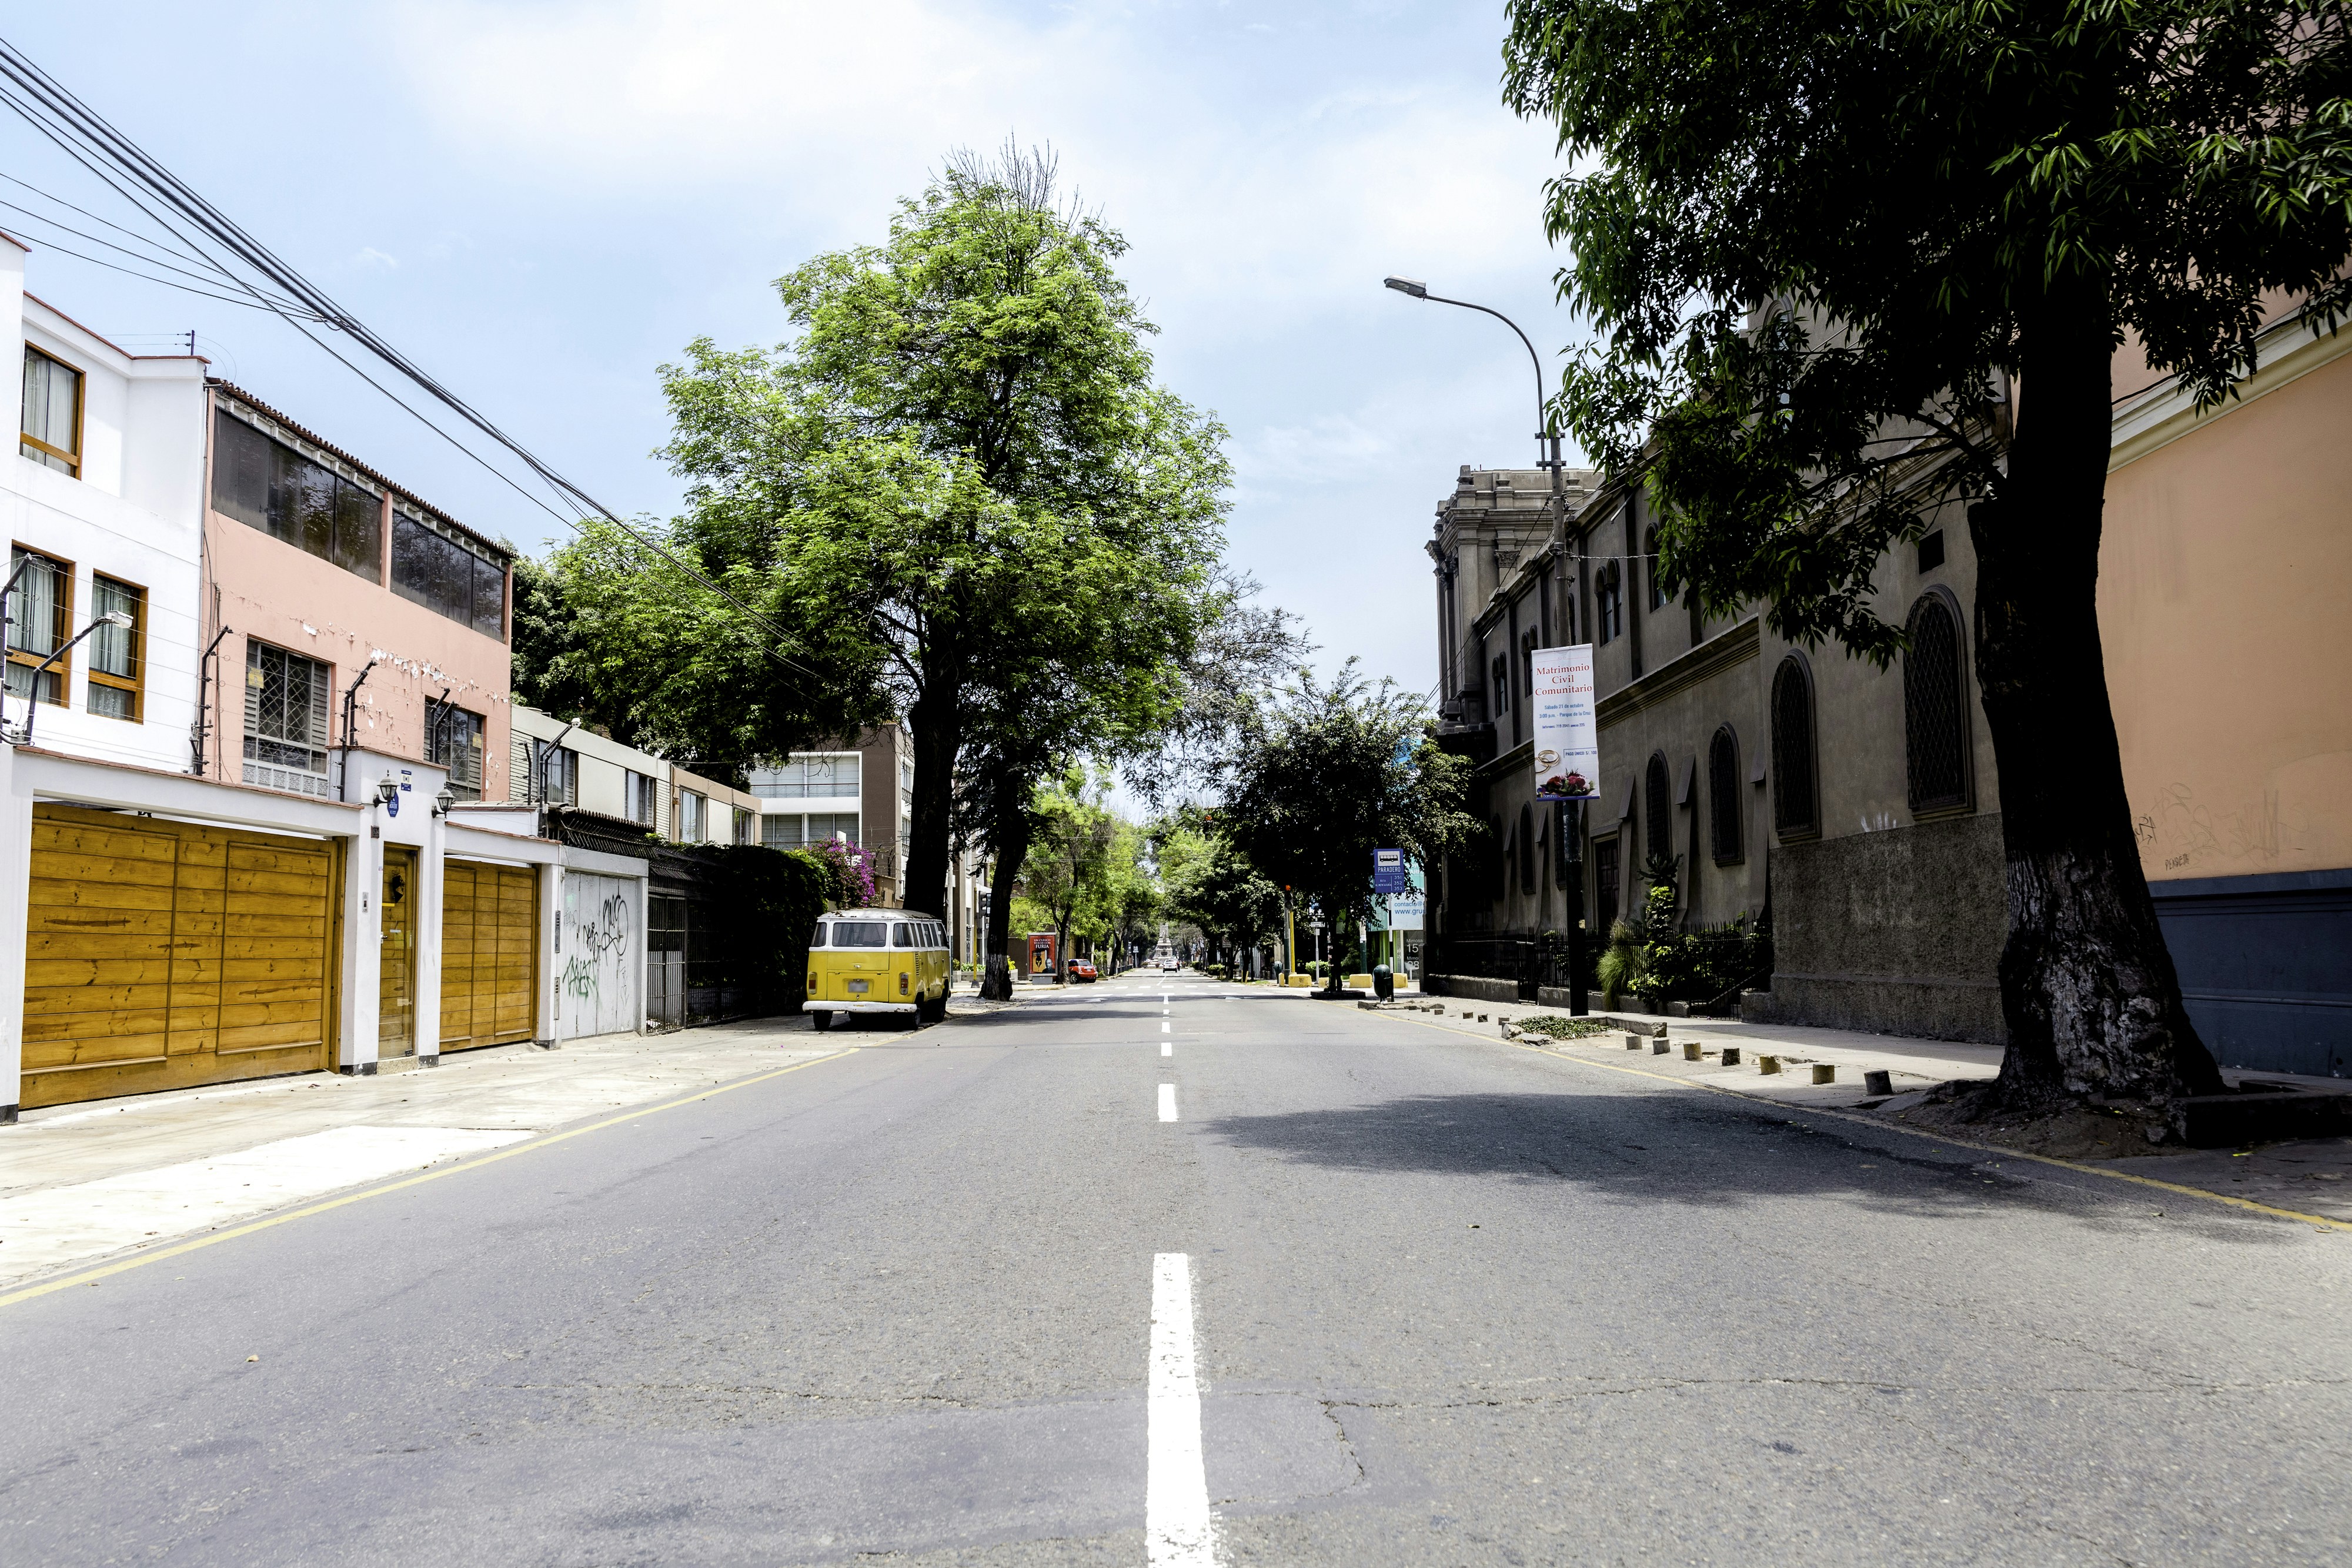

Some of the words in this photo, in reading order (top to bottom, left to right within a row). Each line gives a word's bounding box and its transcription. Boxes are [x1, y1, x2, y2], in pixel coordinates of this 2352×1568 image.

[1536, 664, 1589, 675] Matrimonio
[1552, 675, 1574, 684] Civil
[1535, 684, 1592, 696] Comunitario
[1406, 944, 1419, 953] 15
